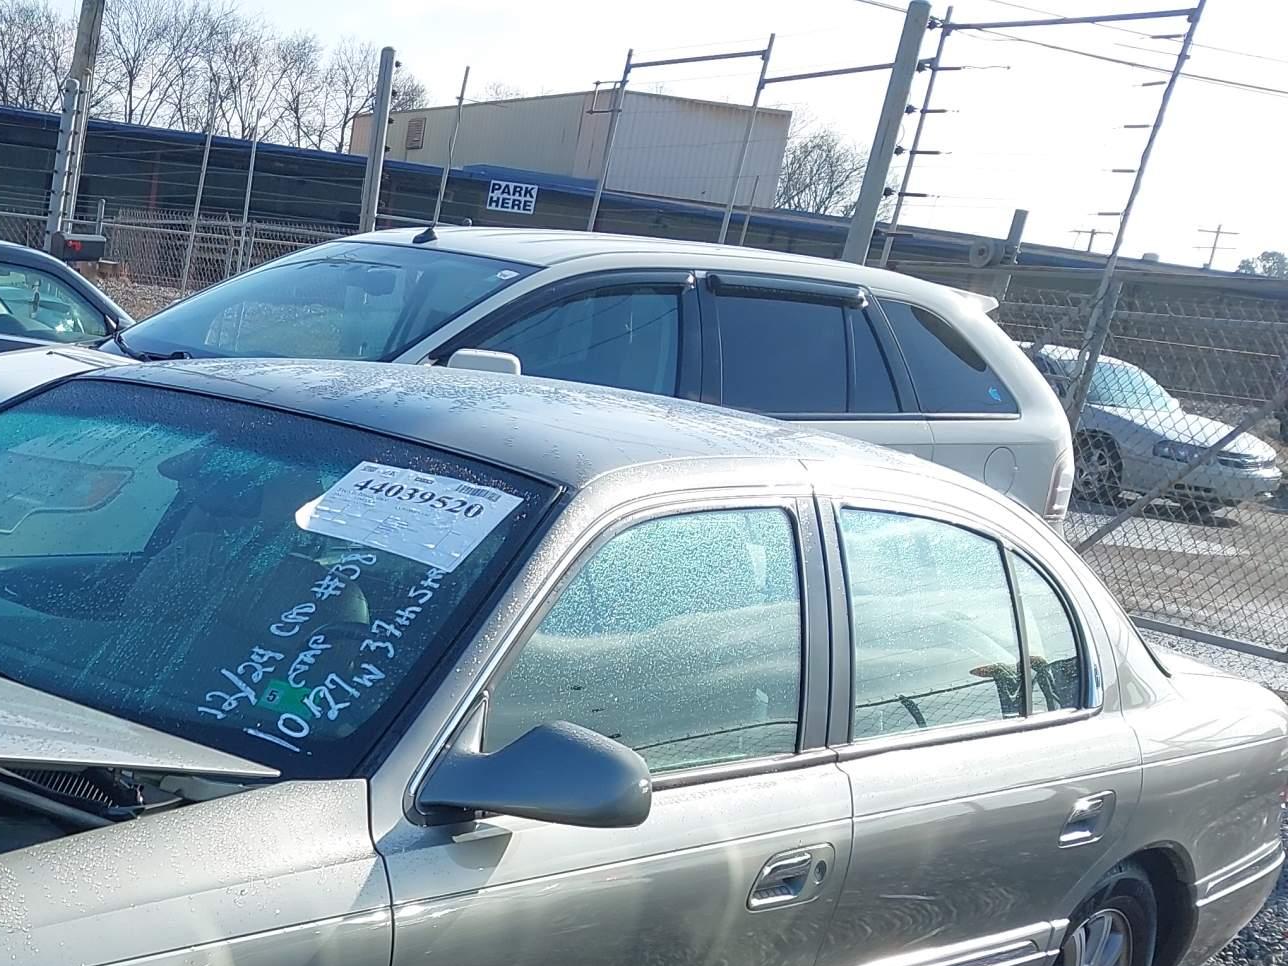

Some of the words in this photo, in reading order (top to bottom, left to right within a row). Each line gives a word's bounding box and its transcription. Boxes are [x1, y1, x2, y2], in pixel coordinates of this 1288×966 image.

[491, 182, 535, 199] PARK
[488, 195, 533, 212] HERE
[354, 477, 486, 520] 44039520
